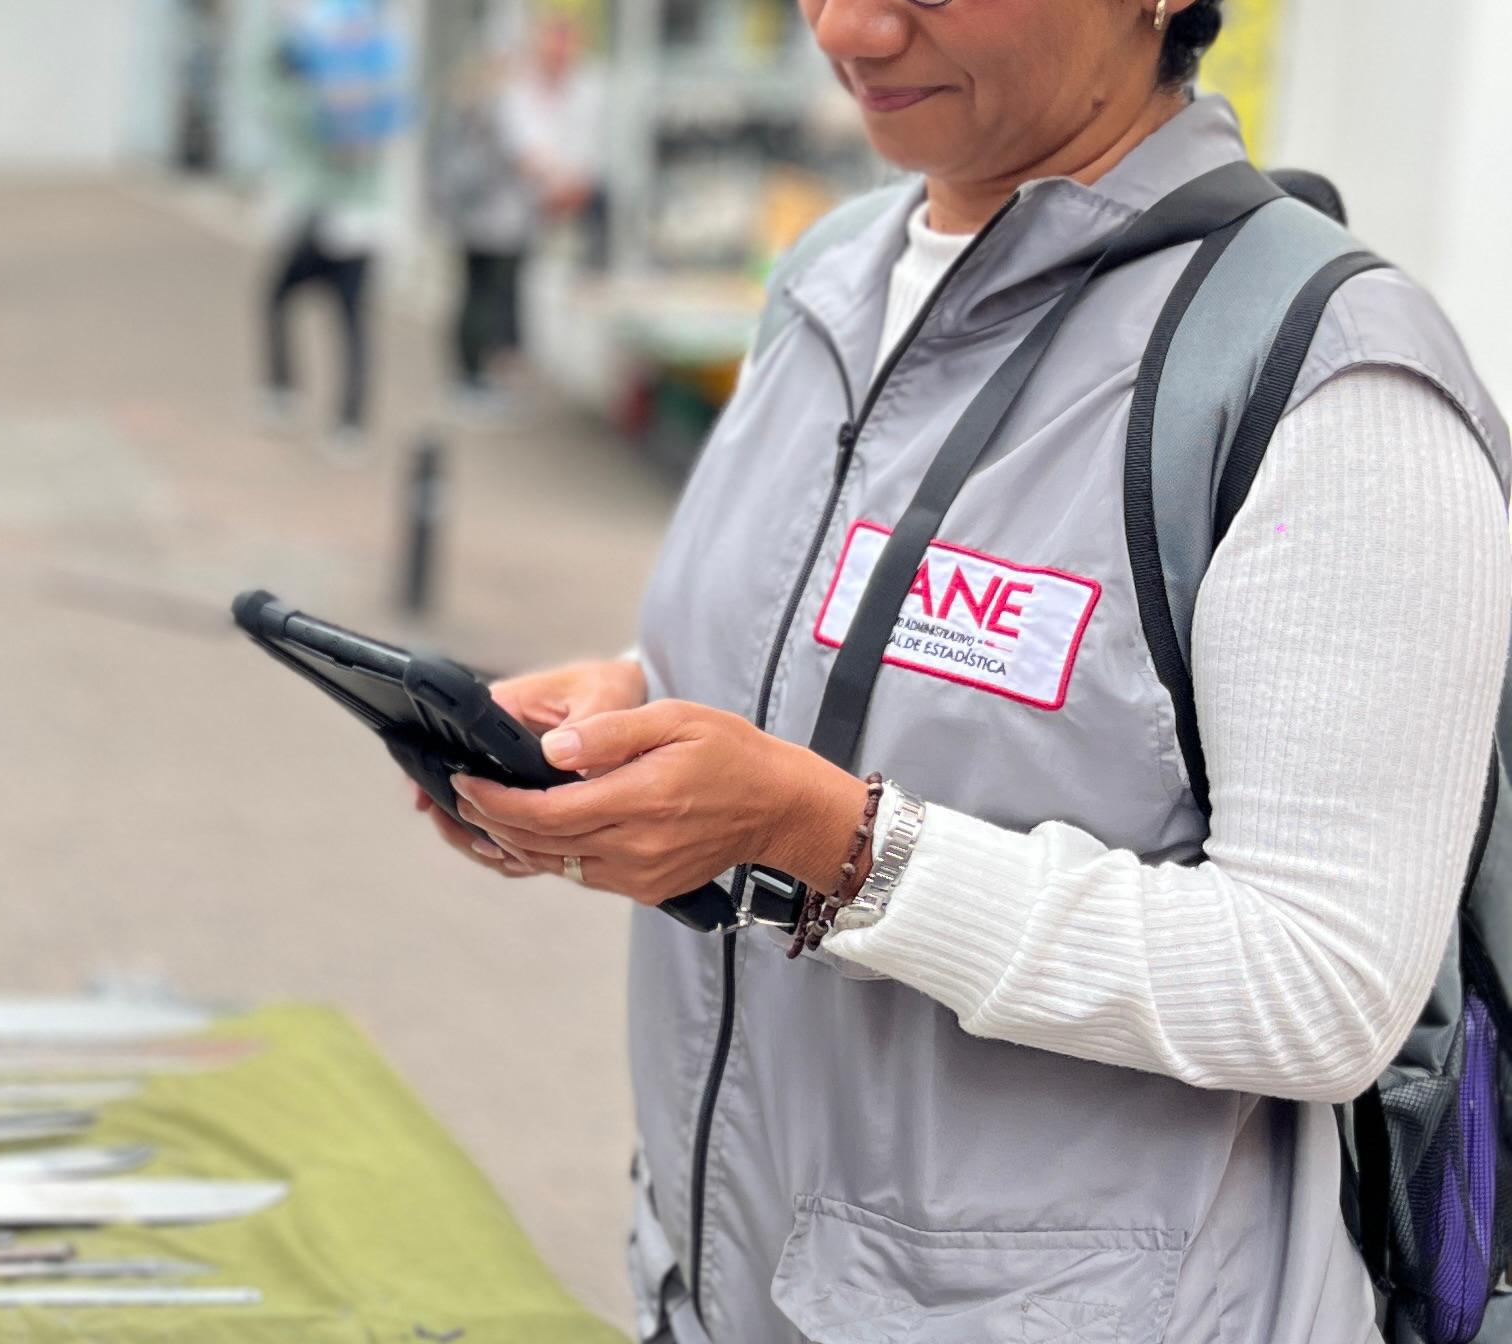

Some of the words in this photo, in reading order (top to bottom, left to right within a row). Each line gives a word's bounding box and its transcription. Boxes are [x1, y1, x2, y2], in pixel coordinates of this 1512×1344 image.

[908, 557, 1035, 640] ANE
[903, 636, 921, 652] DE
[923, 641, 1007, 676] ESTADÍSTICA
